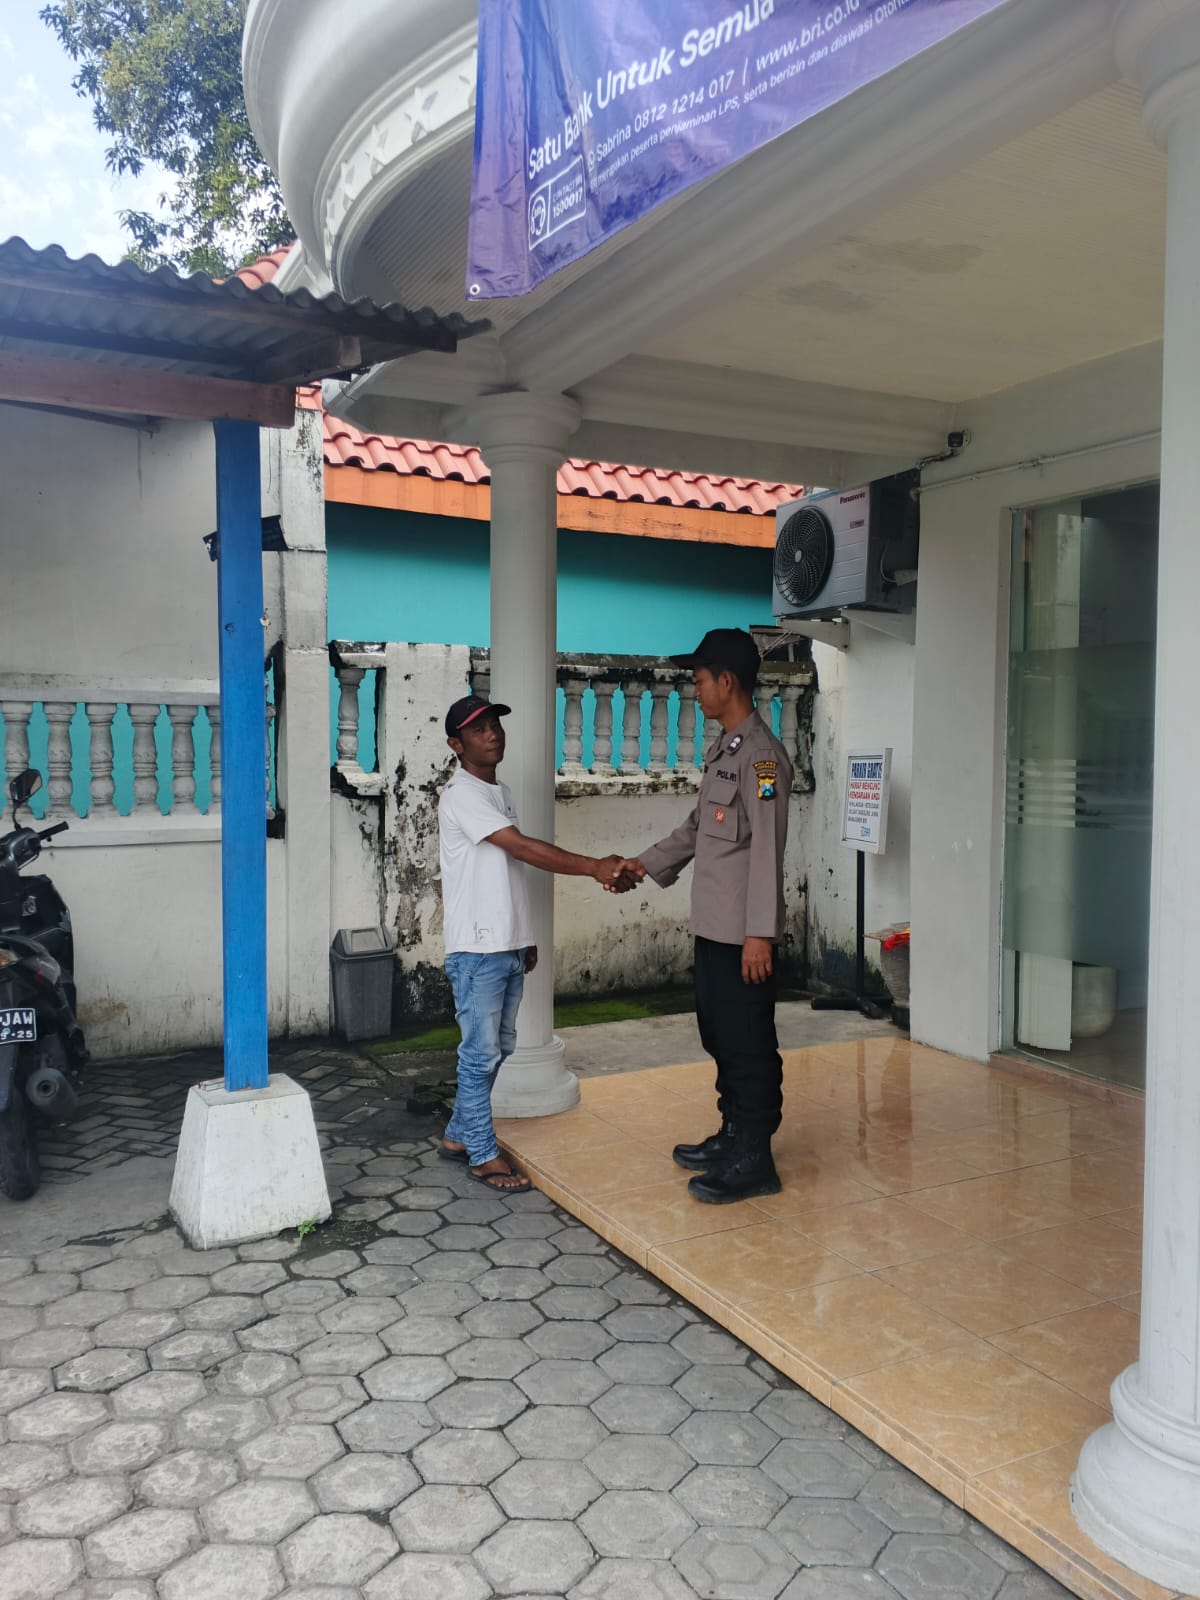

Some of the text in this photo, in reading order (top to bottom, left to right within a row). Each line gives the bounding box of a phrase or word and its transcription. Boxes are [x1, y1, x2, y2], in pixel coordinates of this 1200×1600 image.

[529, 0, 774, 180] Satu Bank Untuk Semua
[630, 132, 659, 162] peserta
[718, 95, 741, 116] LPS,
[743, 80, 768, 104] serta
[769, 60, 806, 88] berizin
[807, 45, 828, 67] dan
[830, 11, 873, 52] diawasi
[596, 124, 631, 162] Sabrina
[634, 103, 667, 133] 0812
[672, 86, 704, 115] 1214
[708, 70, 735, 99] 017
[840, 492, 865, 504] Panasonic
[716, 769, 737, 783] POLRI
[2, 1011, 33, 1026] JAW
